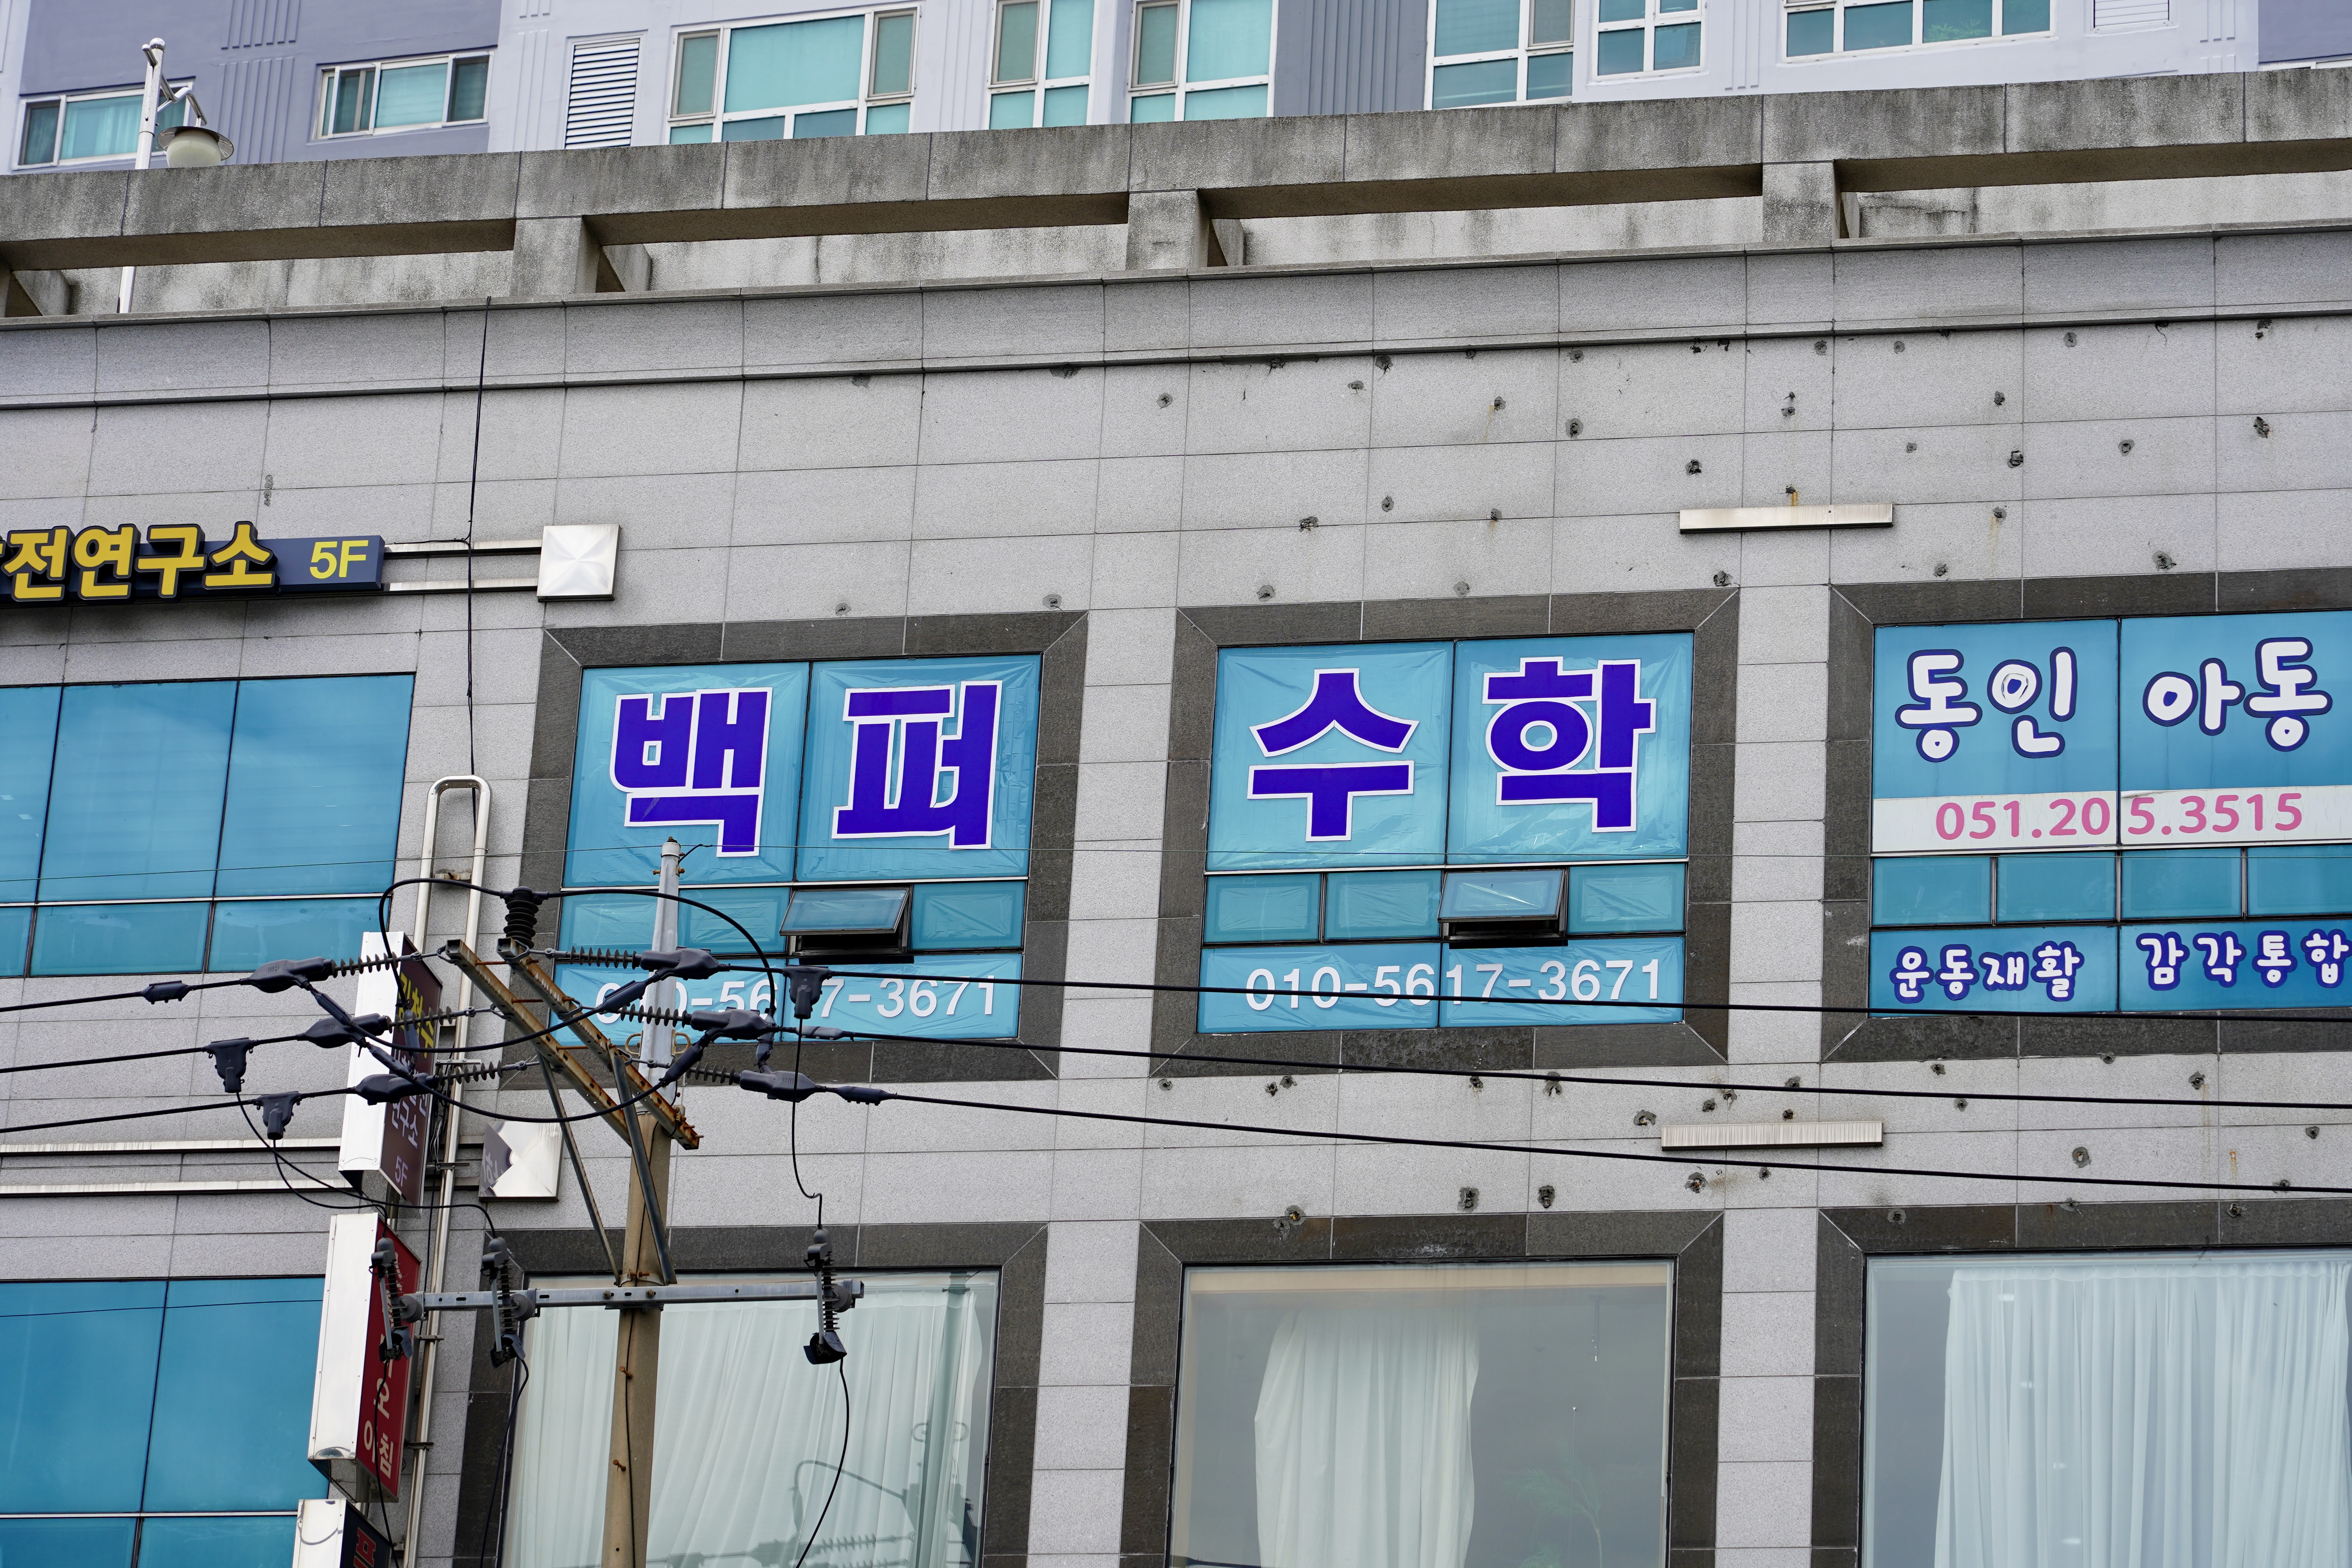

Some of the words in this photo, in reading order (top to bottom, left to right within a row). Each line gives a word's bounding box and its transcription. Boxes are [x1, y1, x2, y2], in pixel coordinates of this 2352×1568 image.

[0, 523, 277, 601] 전연구소
[309, 540, 370, 579] 5F
[1895, 646, 2077, 762] 동인
[2143, 637, 2332, 752] 아동
[610, 681, 1002, 857] 백퍼
[1247, 656, 1657, 842] 수학
[1936, 793, 2303, 840] 051.205.3515
[1245, 958, 1659, 1011] 010-5617-3671
[1890, 941, 2084, 1003] 운동재활
[2136, 929, 2352, 991] 감각통합
[595, 975, 994, 1024] 0-567-3671
[395, 1155, 408, 1187] 5F
[363, 1420, 394, 1479] 아침
